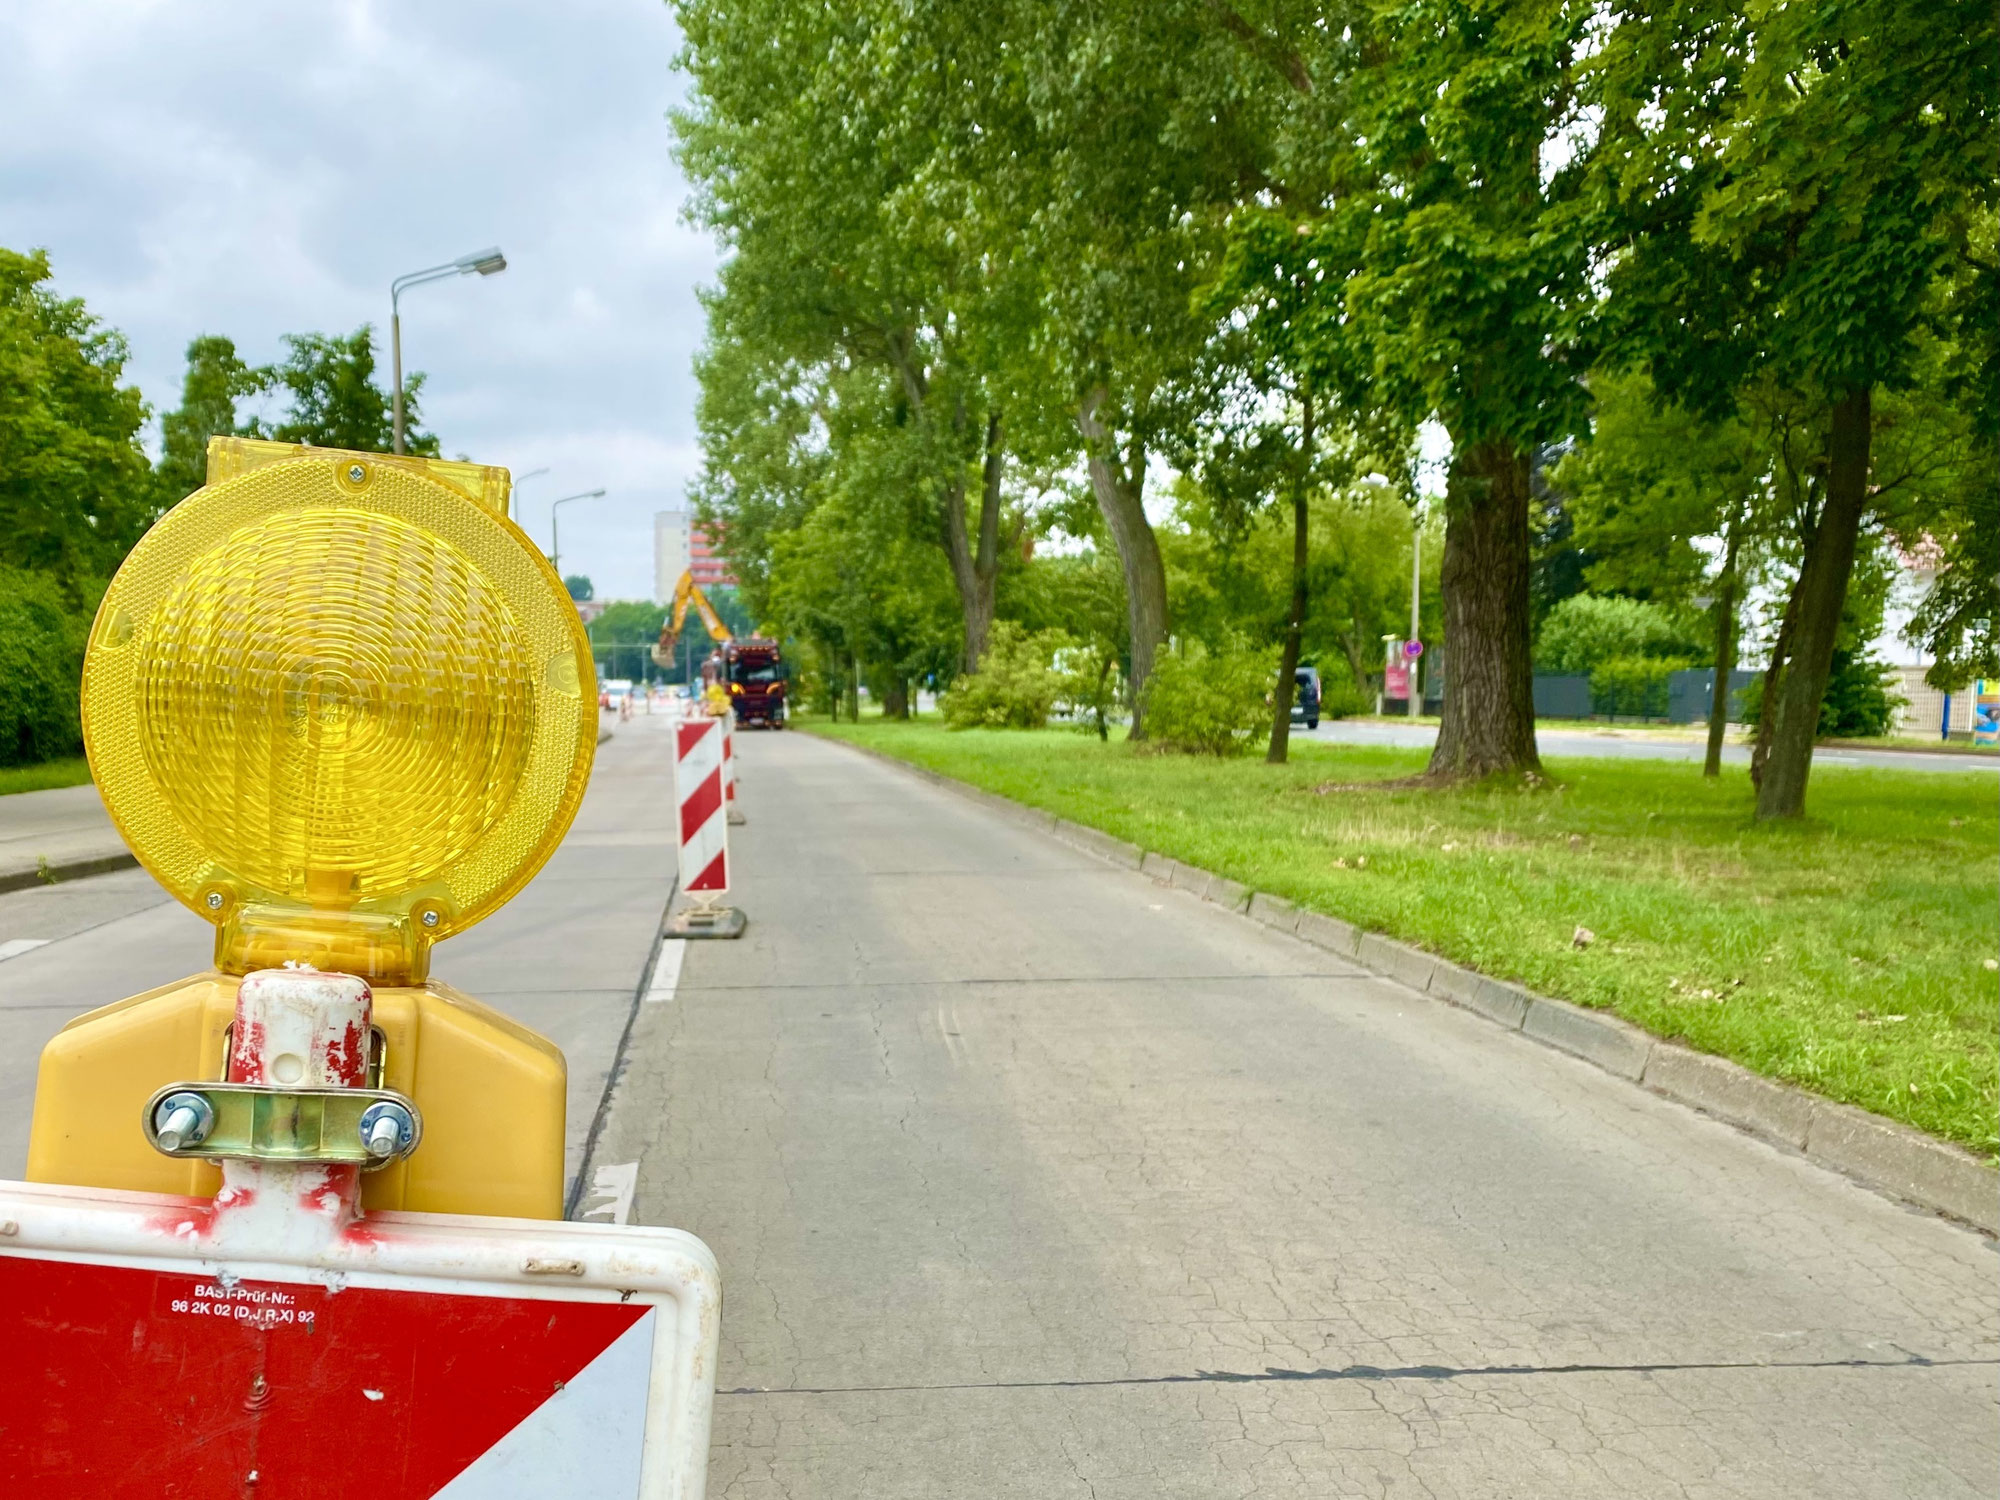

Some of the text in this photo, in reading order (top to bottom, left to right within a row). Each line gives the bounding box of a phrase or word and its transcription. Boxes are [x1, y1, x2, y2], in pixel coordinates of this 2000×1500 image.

[171, 1300, 188, 1312] 96
[191, 1302, 210, 1315] 2K
[214, 1304, 230, 1316] 02
[297, 1311, 315, 1323] 92
